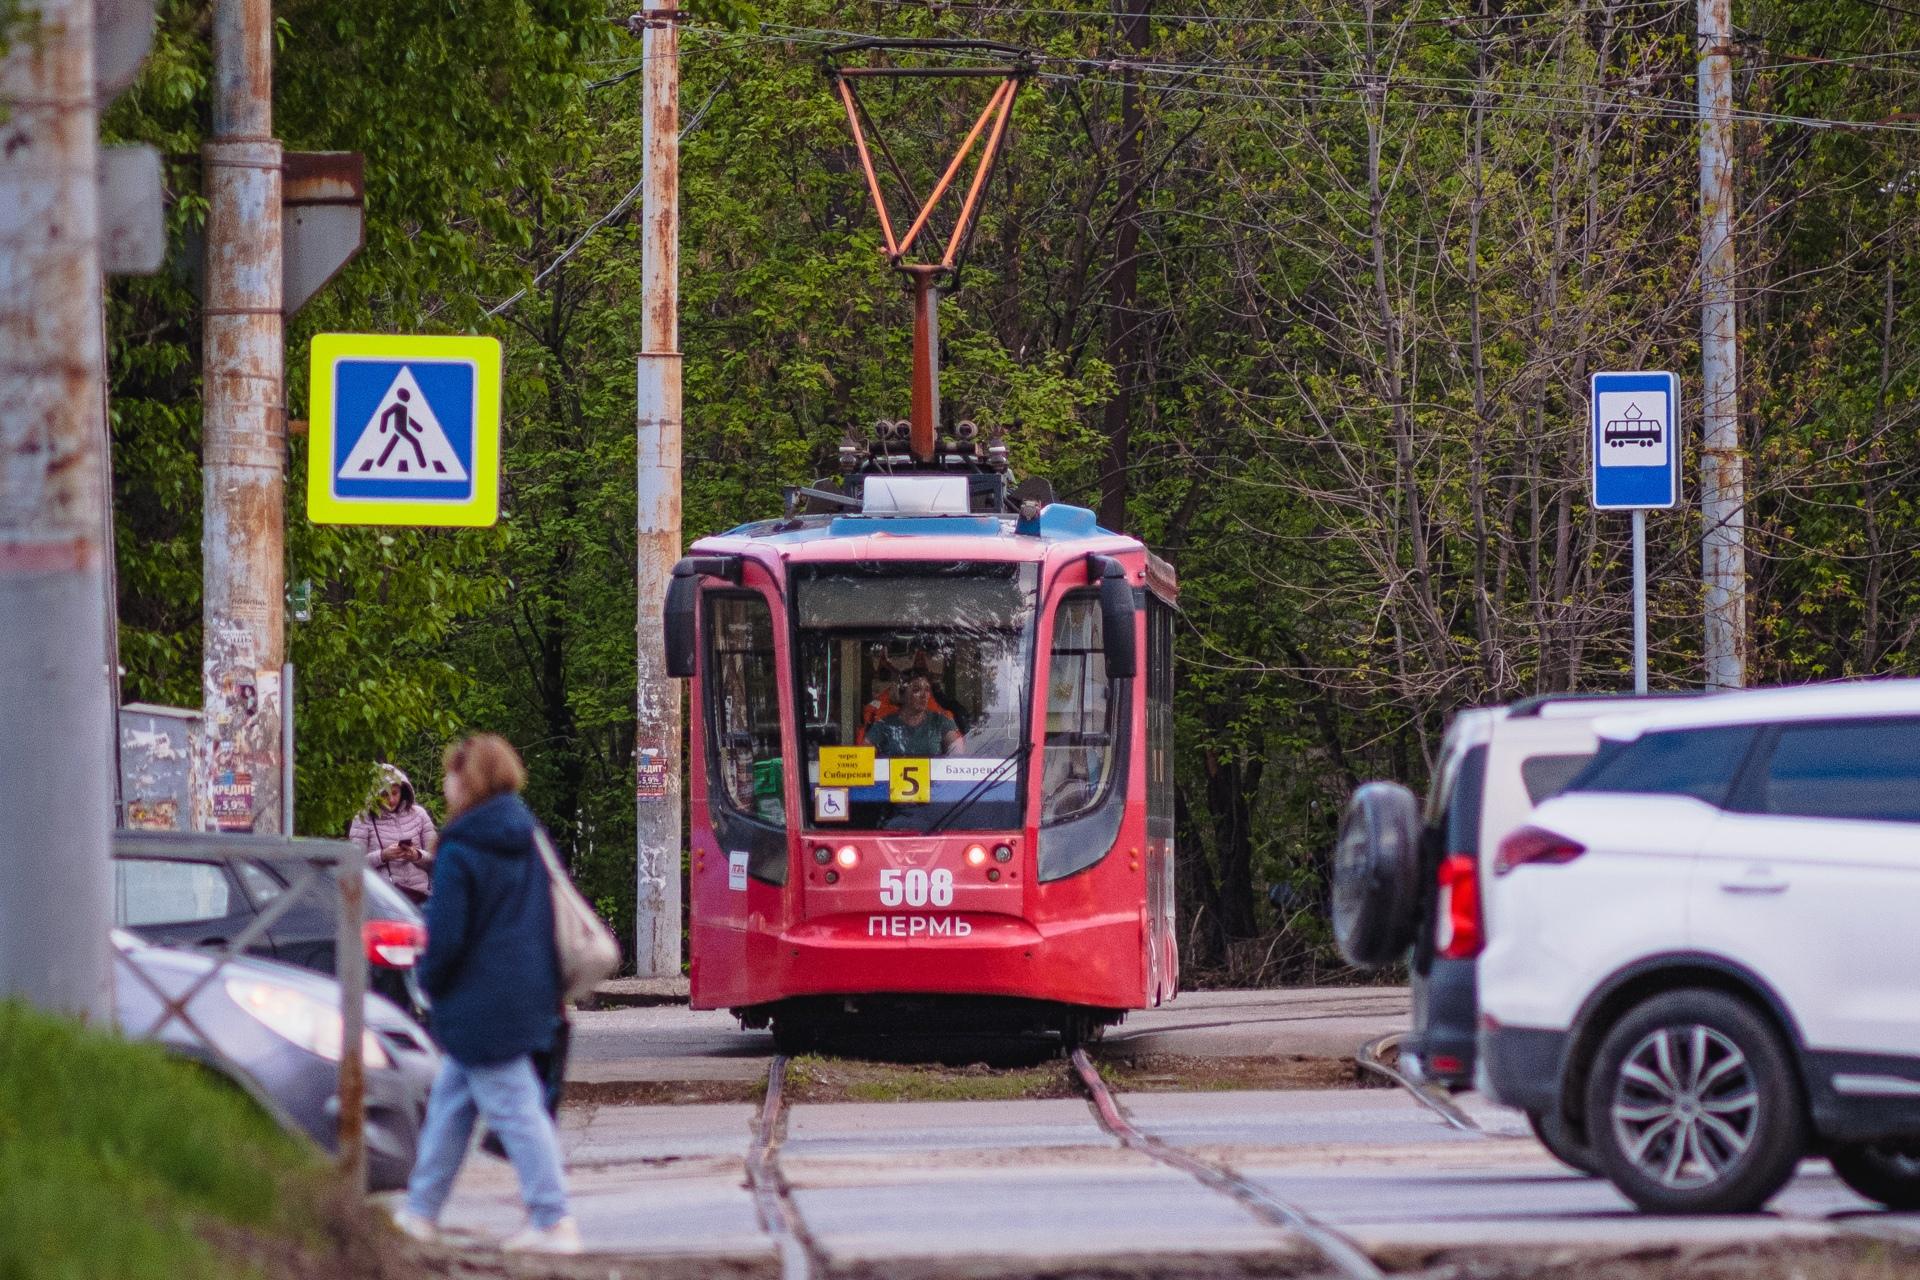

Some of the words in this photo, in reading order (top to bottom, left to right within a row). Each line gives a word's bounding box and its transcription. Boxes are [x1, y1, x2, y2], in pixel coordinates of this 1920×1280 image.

[901, 766, 920, 796] 5
[880, 868, 953, 907] 508
[868, 916, 972, 937] ПЕРМЬ
